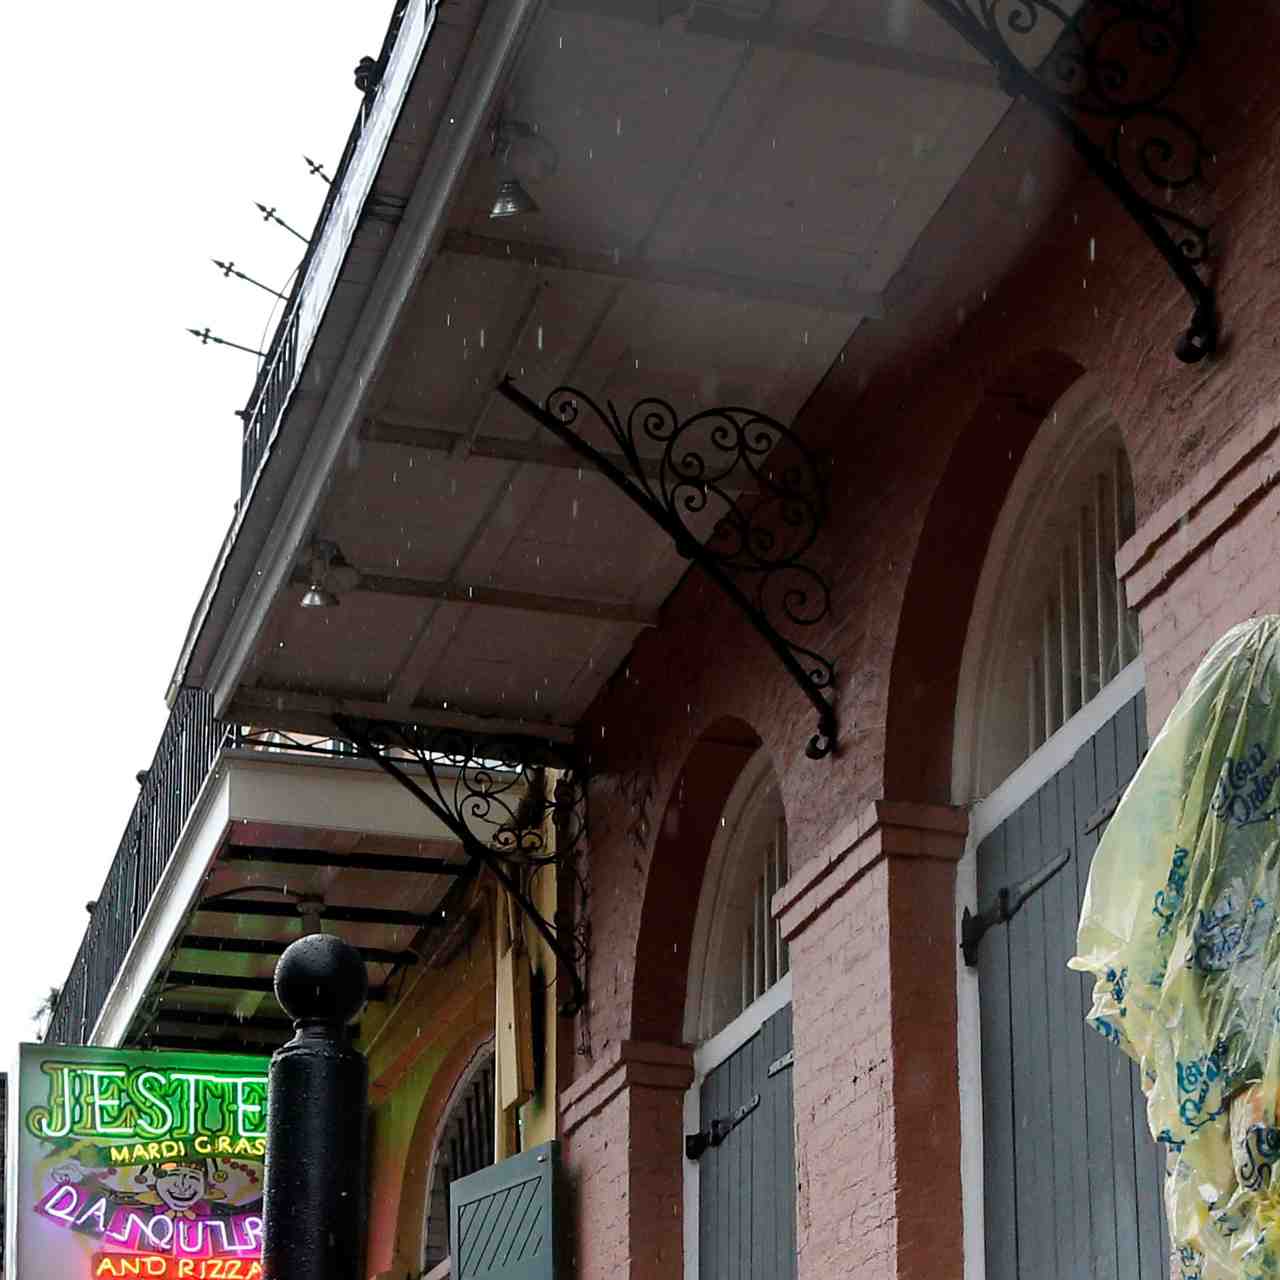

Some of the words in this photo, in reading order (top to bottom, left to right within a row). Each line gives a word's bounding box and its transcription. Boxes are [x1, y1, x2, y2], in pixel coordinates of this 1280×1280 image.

[26, 1061, 271, 1138] JESTE
[110, 1141, 185, 1162] MARDI
[195, 1136, 266, 1157] GRAS
[43, 1185, 264, 1252] DAIQUIR
[96, 1256, 167, 1277] AND
